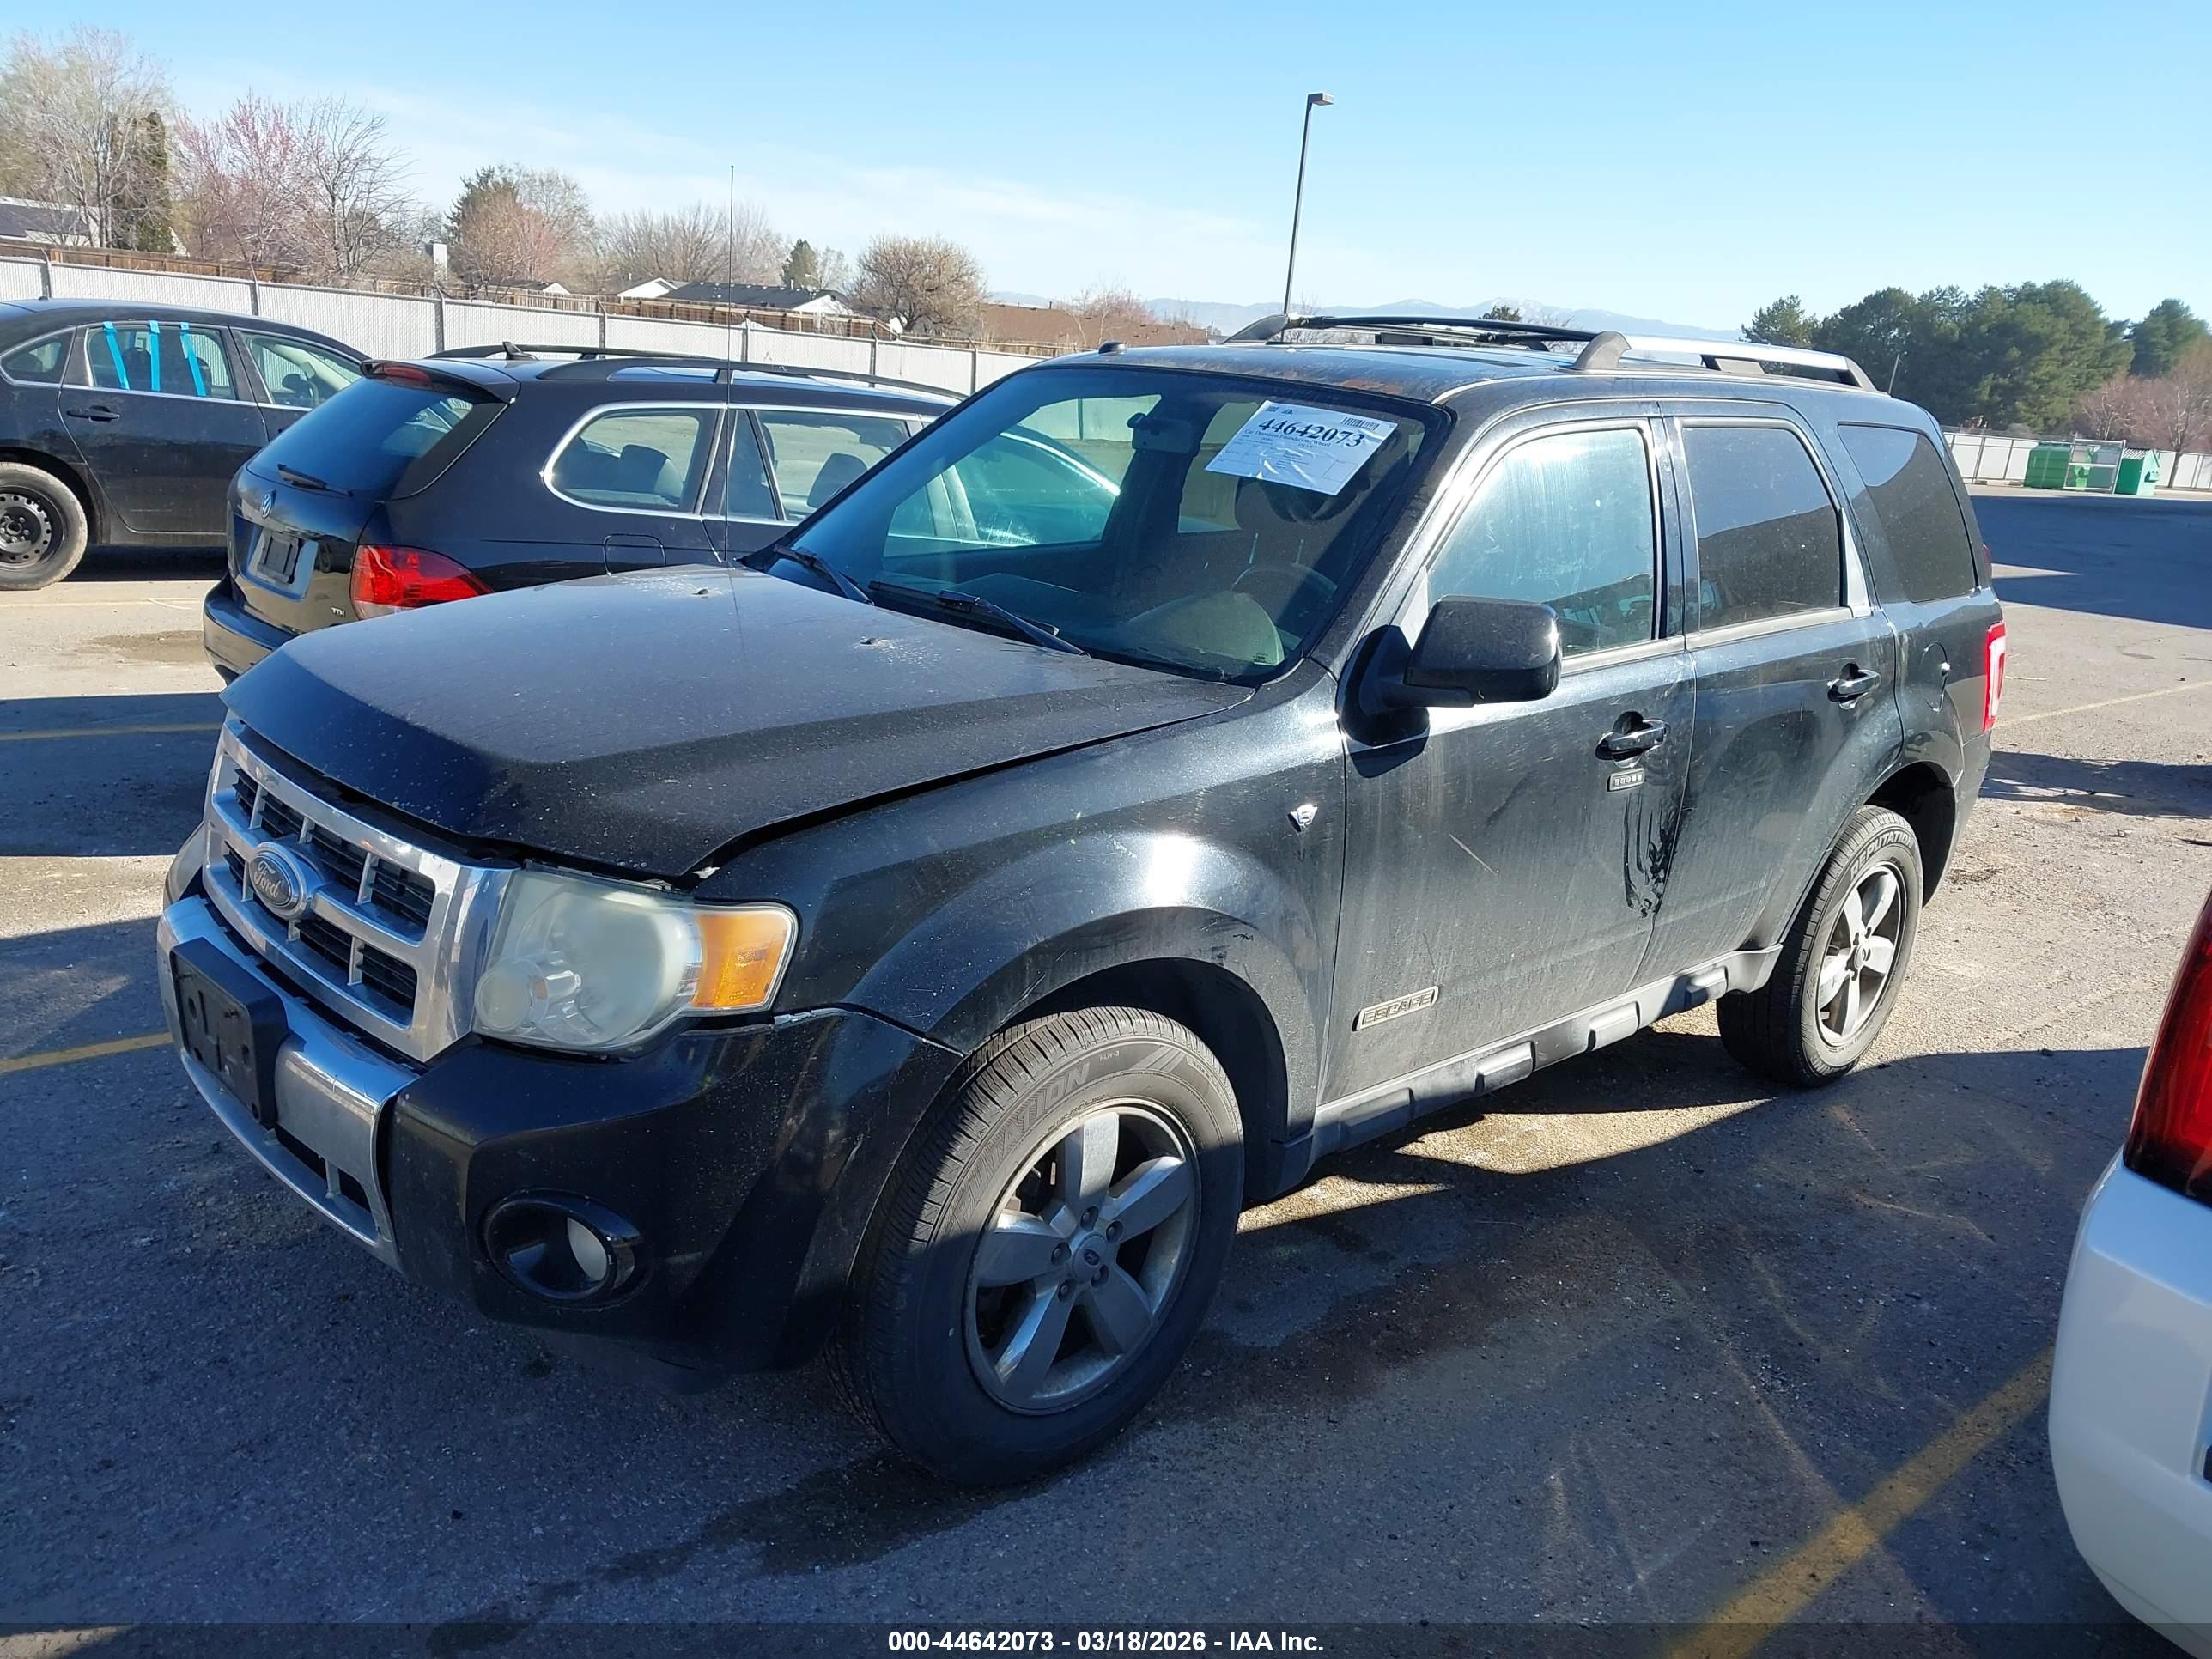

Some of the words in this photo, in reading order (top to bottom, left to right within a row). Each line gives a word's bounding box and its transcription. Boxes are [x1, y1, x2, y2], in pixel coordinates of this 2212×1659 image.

[1258, 418, 1365, 447] 44642073
[1850, 830, 1915, 881] REPUTATION
[253, 860, 282, 898] Ford
[1363, 992, 1432, 1024] ESCAPE
